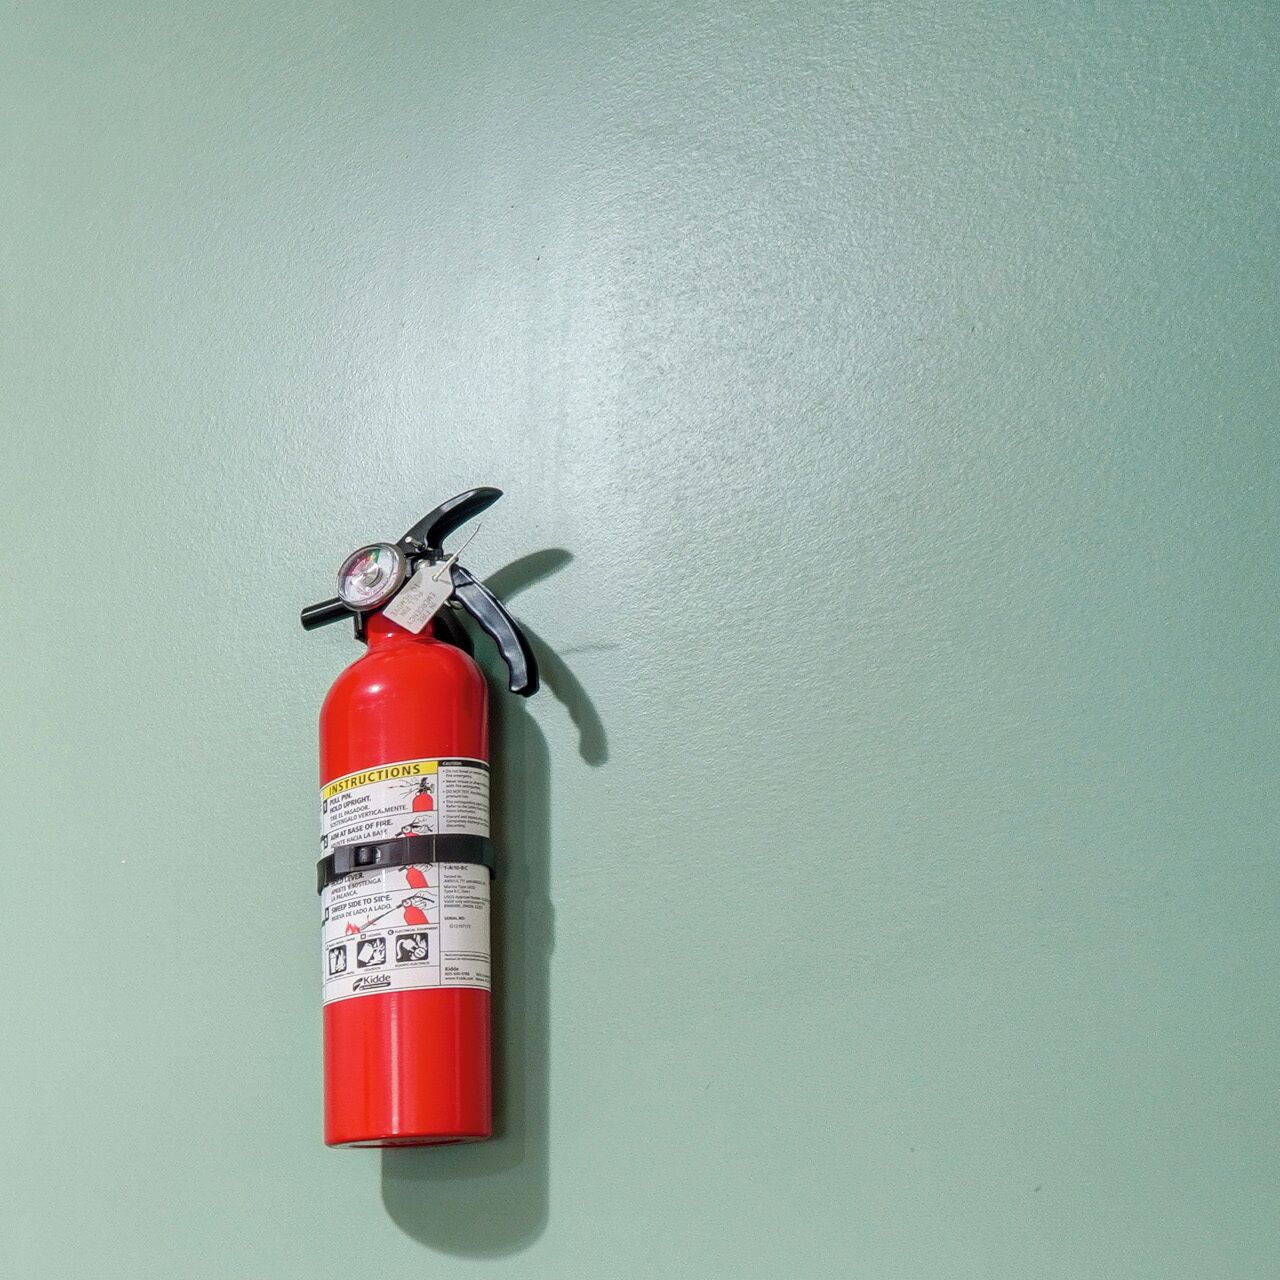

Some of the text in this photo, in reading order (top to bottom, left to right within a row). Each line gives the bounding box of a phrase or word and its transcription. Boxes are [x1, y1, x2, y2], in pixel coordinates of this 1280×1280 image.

[329, 764, 420, 795] INSTRUCTIONS
[330, 797, 340, 806] PULL
[330, 795, 371, 813] HOLD UPRIGHT.
[348, 826, 363, 835] BASE
[332, 904, 347, 913] SWEEP
[348, 900, 362, 909] SIDE
[353, 907, 367, 915] LADO
[363, 974, 391, 984] Kidde
